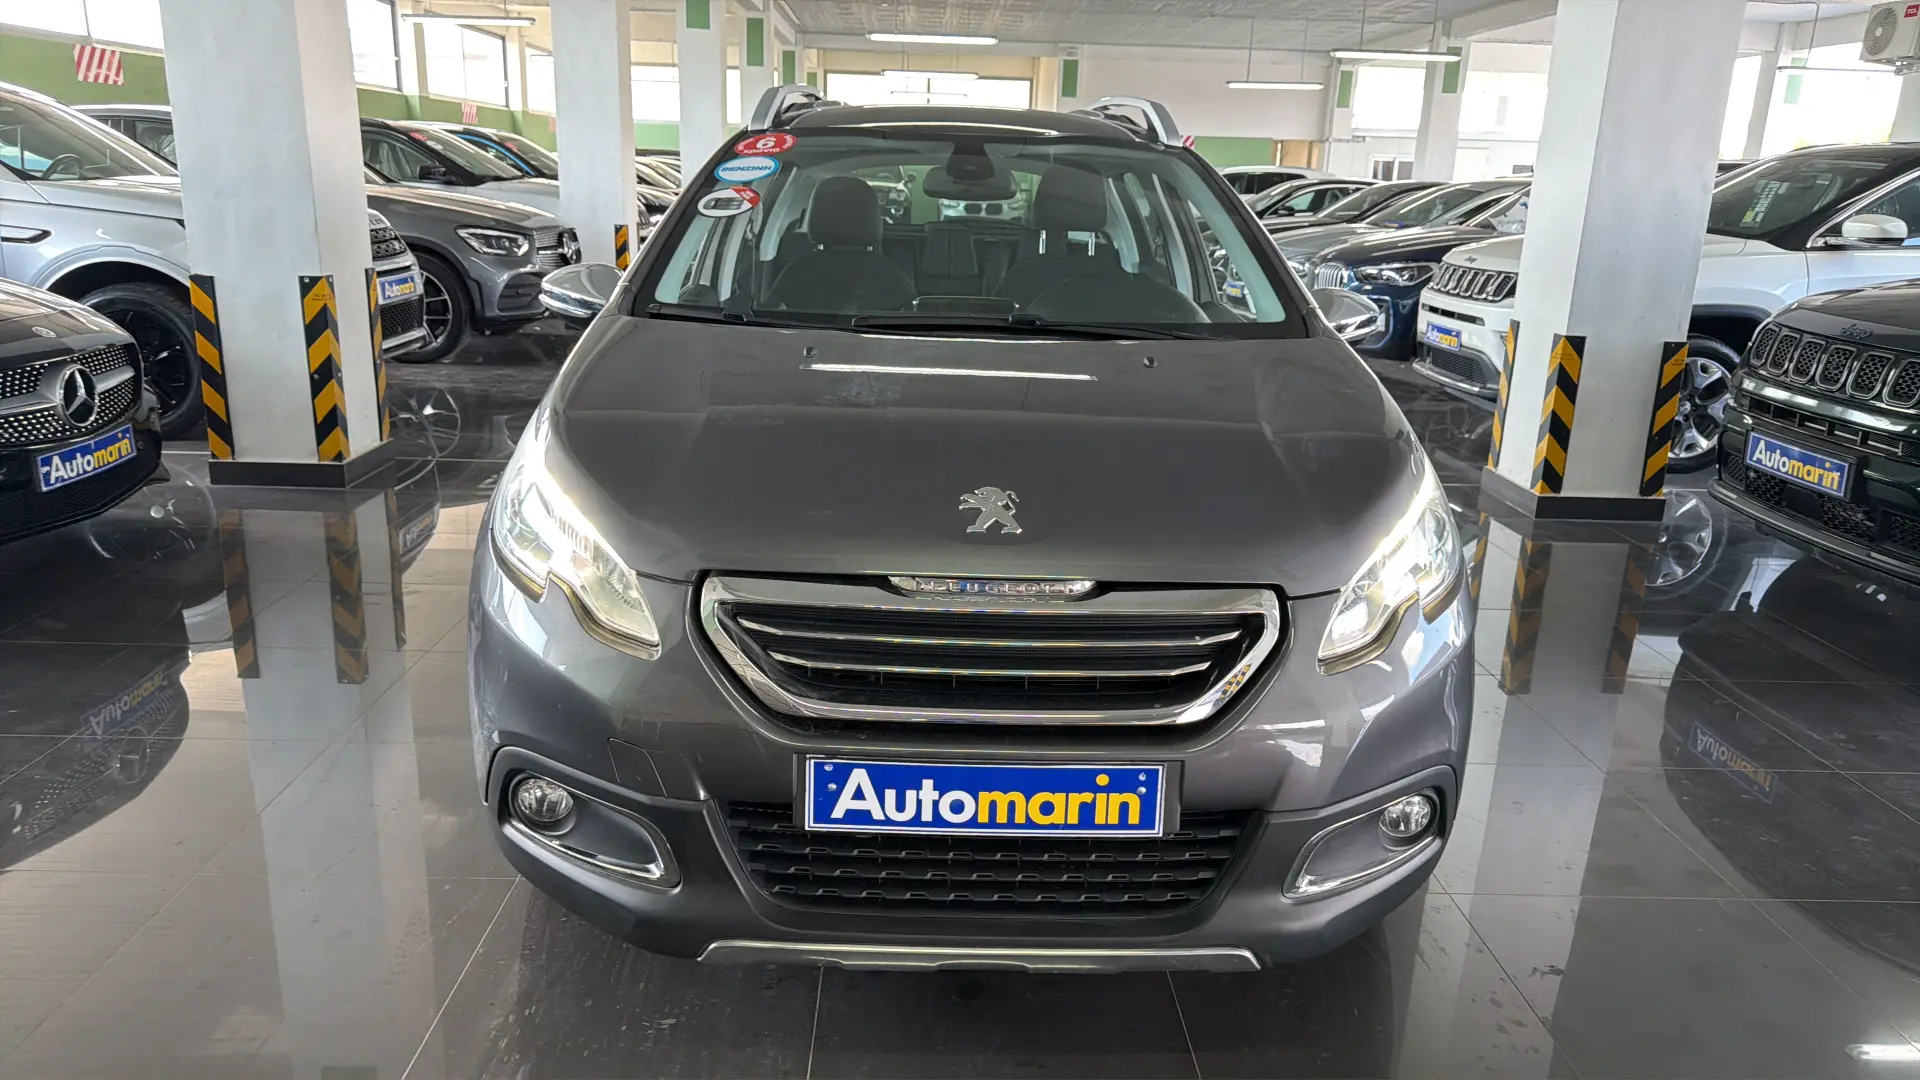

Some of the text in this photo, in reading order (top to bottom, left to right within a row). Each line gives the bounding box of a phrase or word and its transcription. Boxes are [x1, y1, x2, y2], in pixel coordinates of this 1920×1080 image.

[756, 136, 776, 149] 6
[385, 278, 416, 298] Automarin
[1426, 324, 1458, 347] Automarin
[50, 433, 131, 484] Automarin
[1752, 440, 1841, 490] Automarin
[931, 580, 1057, 593] PEUGEOT
[830, 768, 1140, 825] Automarin
